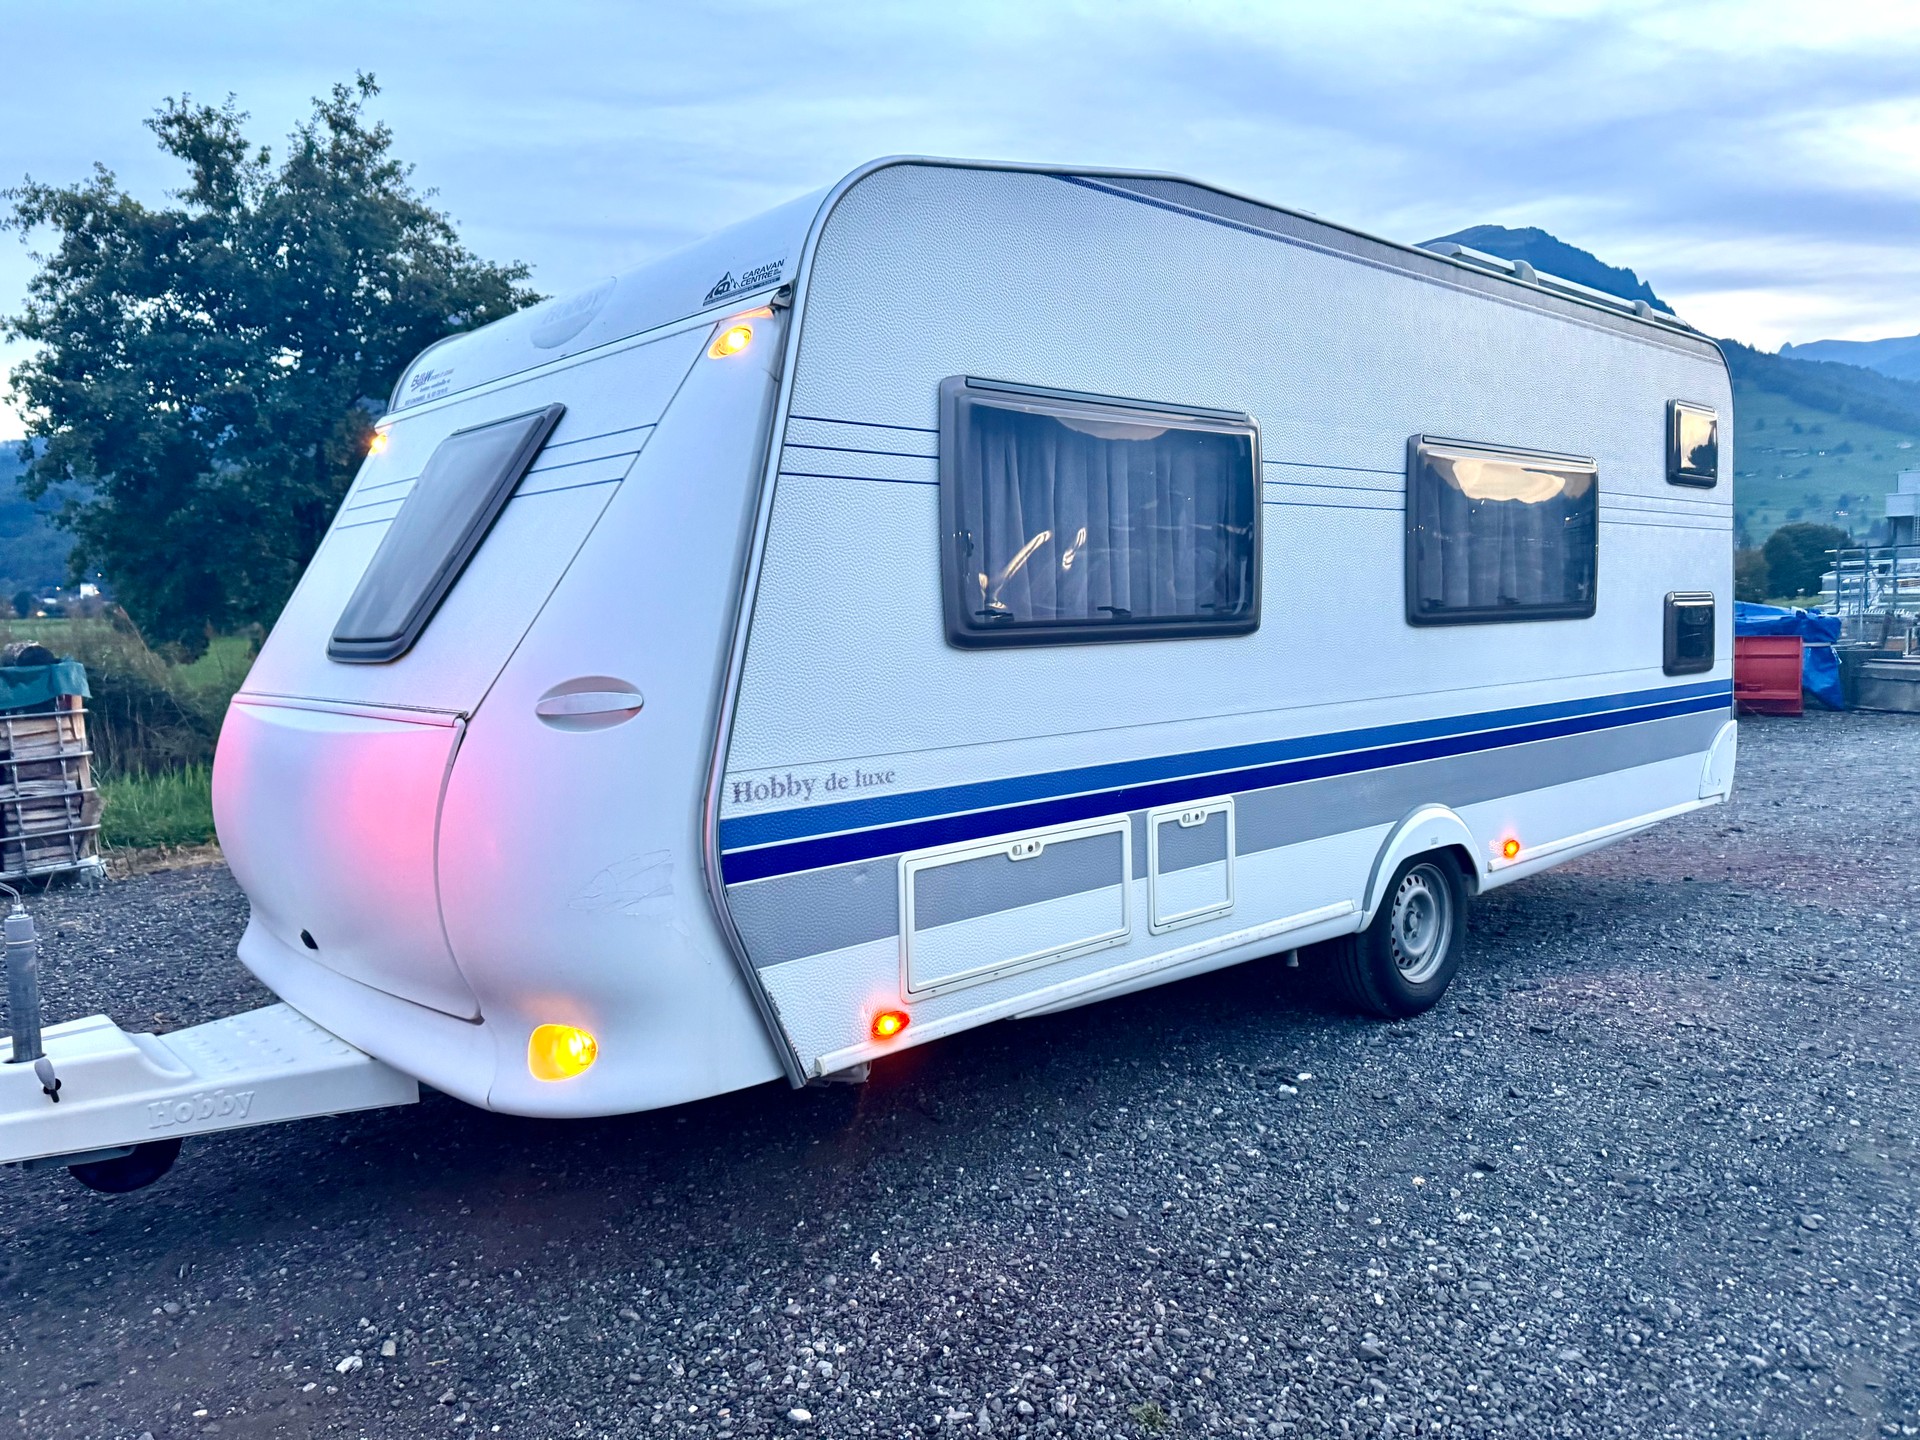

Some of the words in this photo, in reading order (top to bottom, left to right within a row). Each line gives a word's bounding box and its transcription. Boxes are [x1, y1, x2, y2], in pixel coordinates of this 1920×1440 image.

[740, 270, 774, 287] CENTRE
[742, 259, 785, 280] CARAVAN
[732, 772, 816, 804] Hobby
[824, 772, 849, 792] de
[855, 769, 896, 788] luxe
[147, 1089, 255, 1130] Hobby
